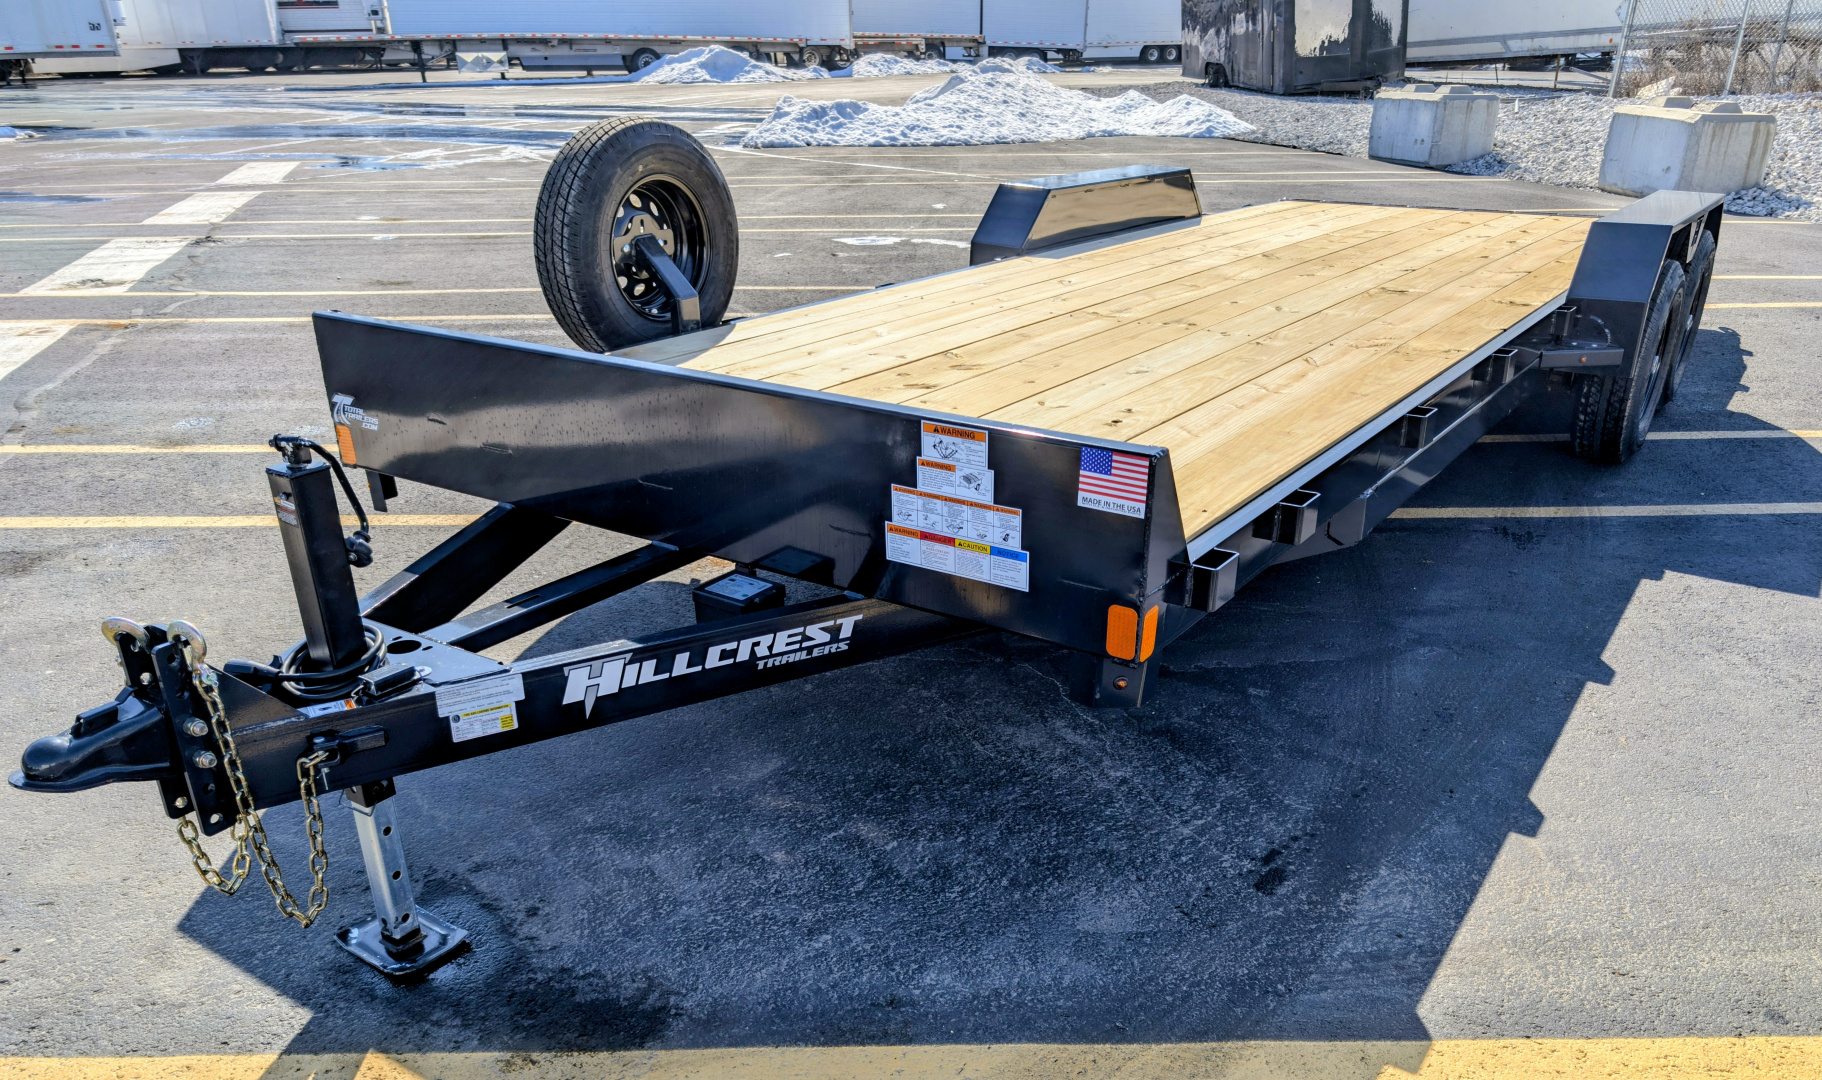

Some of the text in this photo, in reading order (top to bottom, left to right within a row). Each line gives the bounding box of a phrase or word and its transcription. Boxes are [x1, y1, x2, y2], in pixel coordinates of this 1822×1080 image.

[344, 405, 366, 416] TOTAL
[344, 412, 379, 424] TRAILERS
[361, 422, 379, 431] .COM
[940, 426, 976, 440] WARNING
[925, 460, 952, 472] WARNING
[1081, 496, 1102, 506] MADE
[1112, 502, 1126, 511] THE
[1126, 504, 1141, 514] USA
[894, 527, 919, 538] WARNING
[928, 534, 952, 545] DANGER
[962, 541, 988, 552] CAUTION
[997, 550, 1020, 559] NOTICE
[756, 640, 850, 670] TRAILERS
[562, 614, 863, 719] HILLCREST
